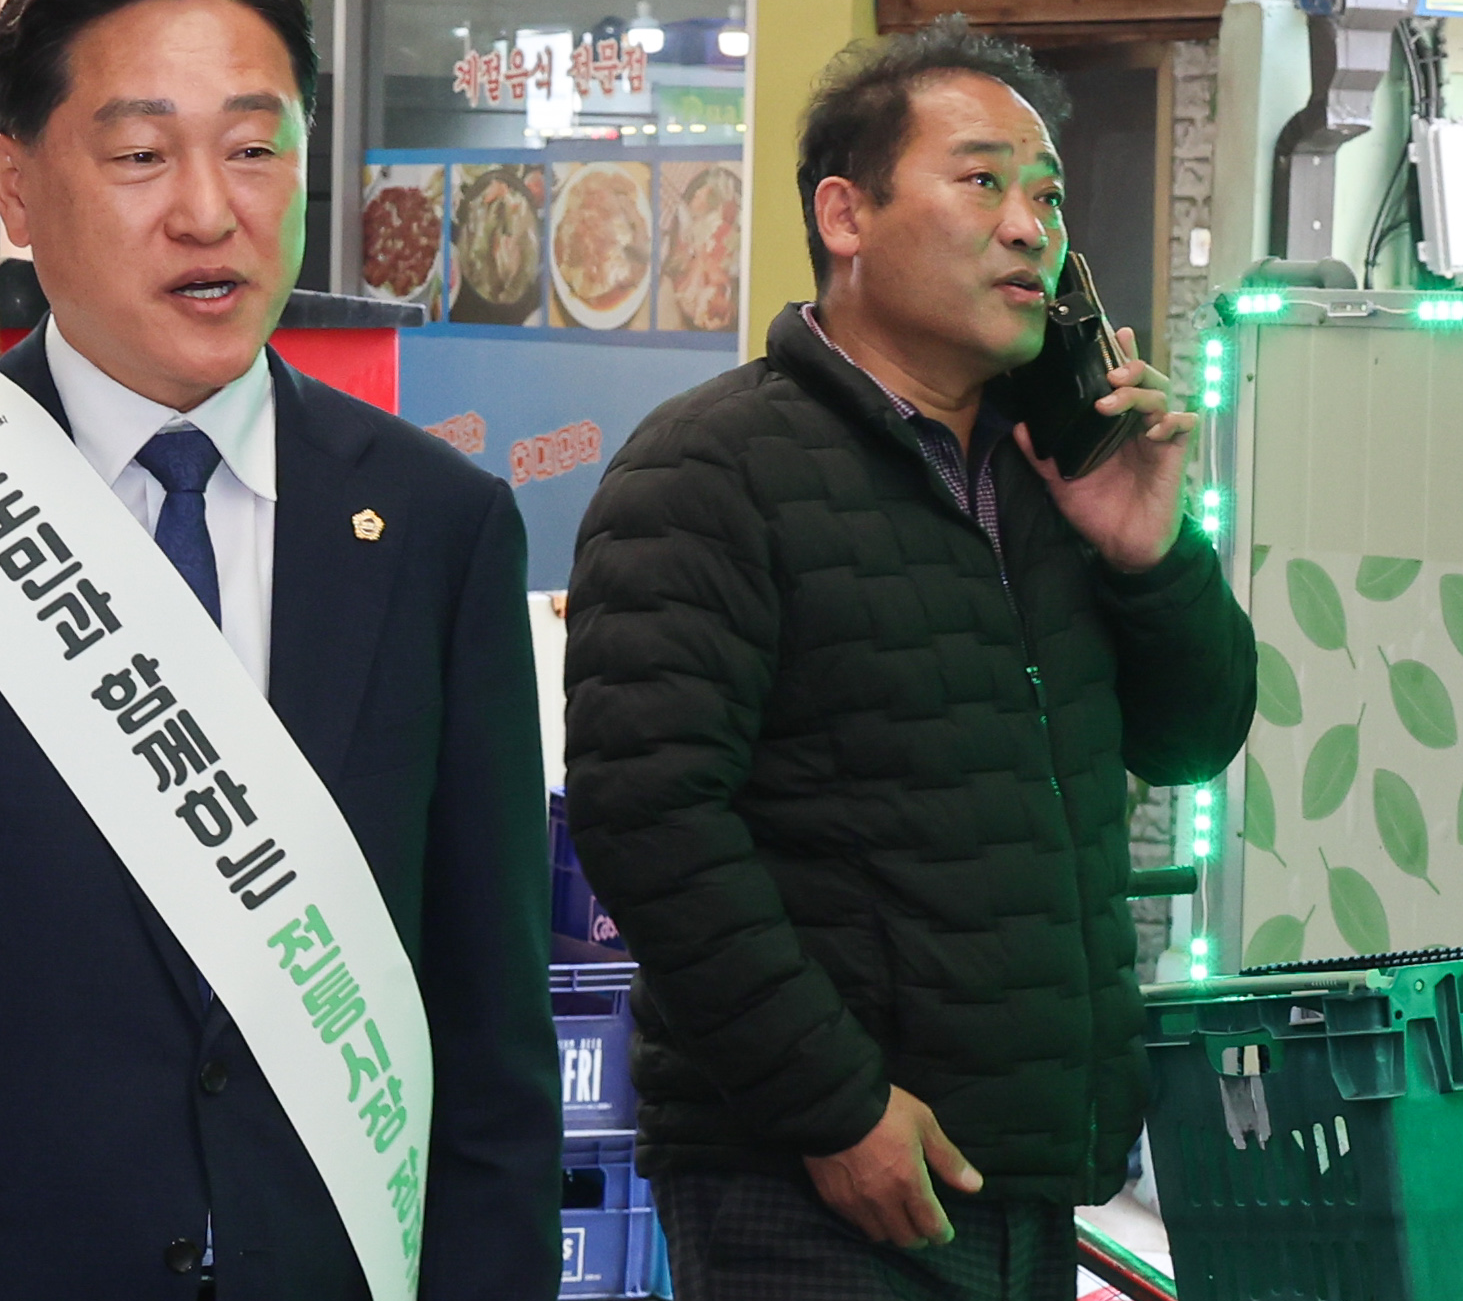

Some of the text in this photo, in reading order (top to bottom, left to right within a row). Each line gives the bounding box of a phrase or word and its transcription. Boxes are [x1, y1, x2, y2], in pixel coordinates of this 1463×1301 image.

[570, 39, 649, 96] 전문점
[90, 651, 297, 911] 함께하는
[265, 903, 406, 1155] 전통시장
